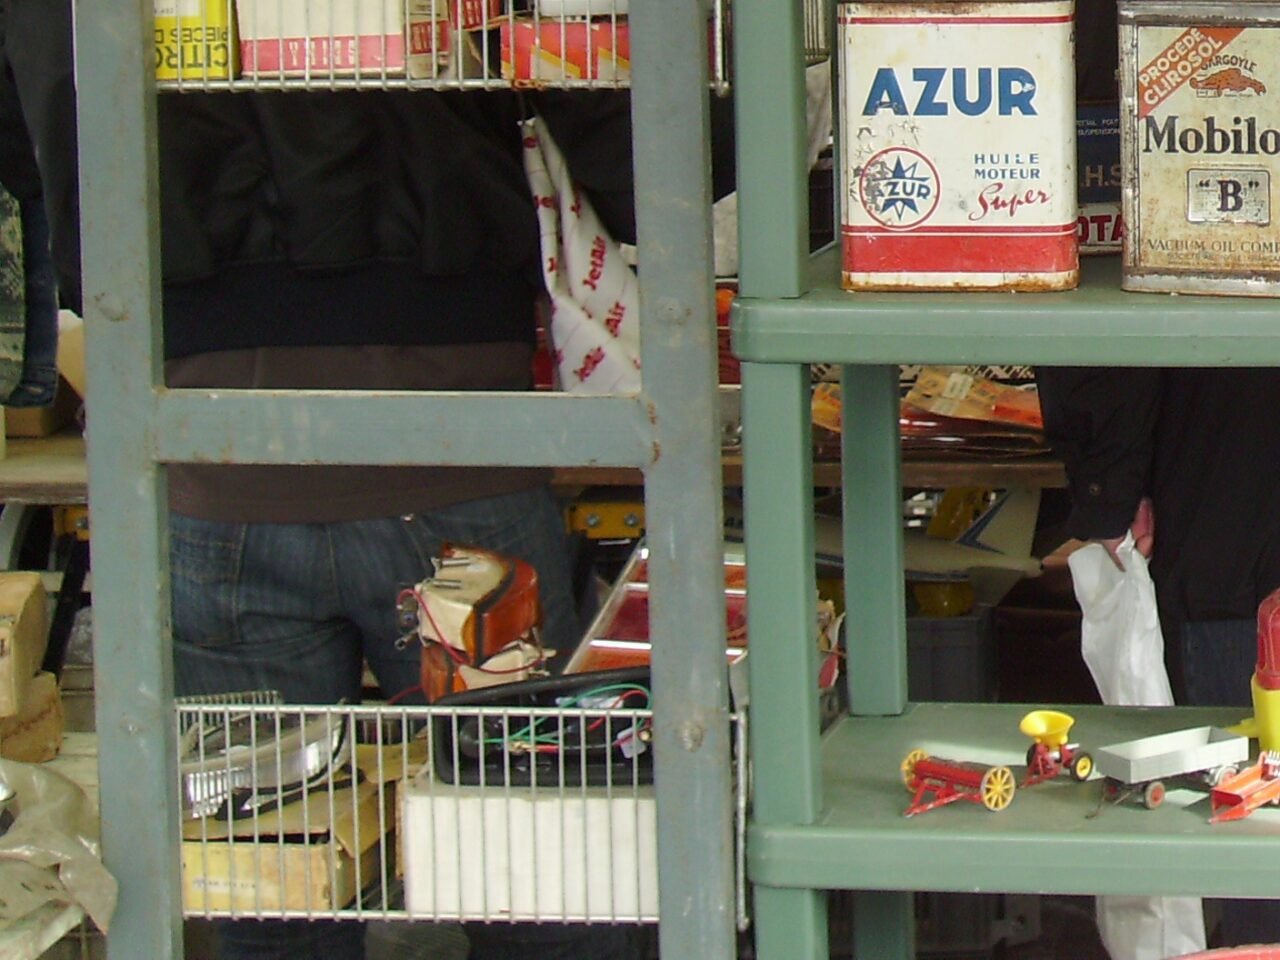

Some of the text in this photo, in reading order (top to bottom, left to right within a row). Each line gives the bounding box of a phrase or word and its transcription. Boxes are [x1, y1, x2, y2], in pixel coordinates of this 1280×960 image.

[1143, 36, 1223, 107] CLIROSOL
[1201, 54, 1257, 73] GARGOYLE
[862, 67, 1039, 117] AZUR
[974, 152, 1040, 165] HUILE
[974, 167, 1041, 180] MOTEUR
[873, 181, 931, 201] AZUR
[968, 181, 1050, 221] Super
[1148, 239, 1206, 252] VACUUM
[1211, 240, 1236, 253] OIL
